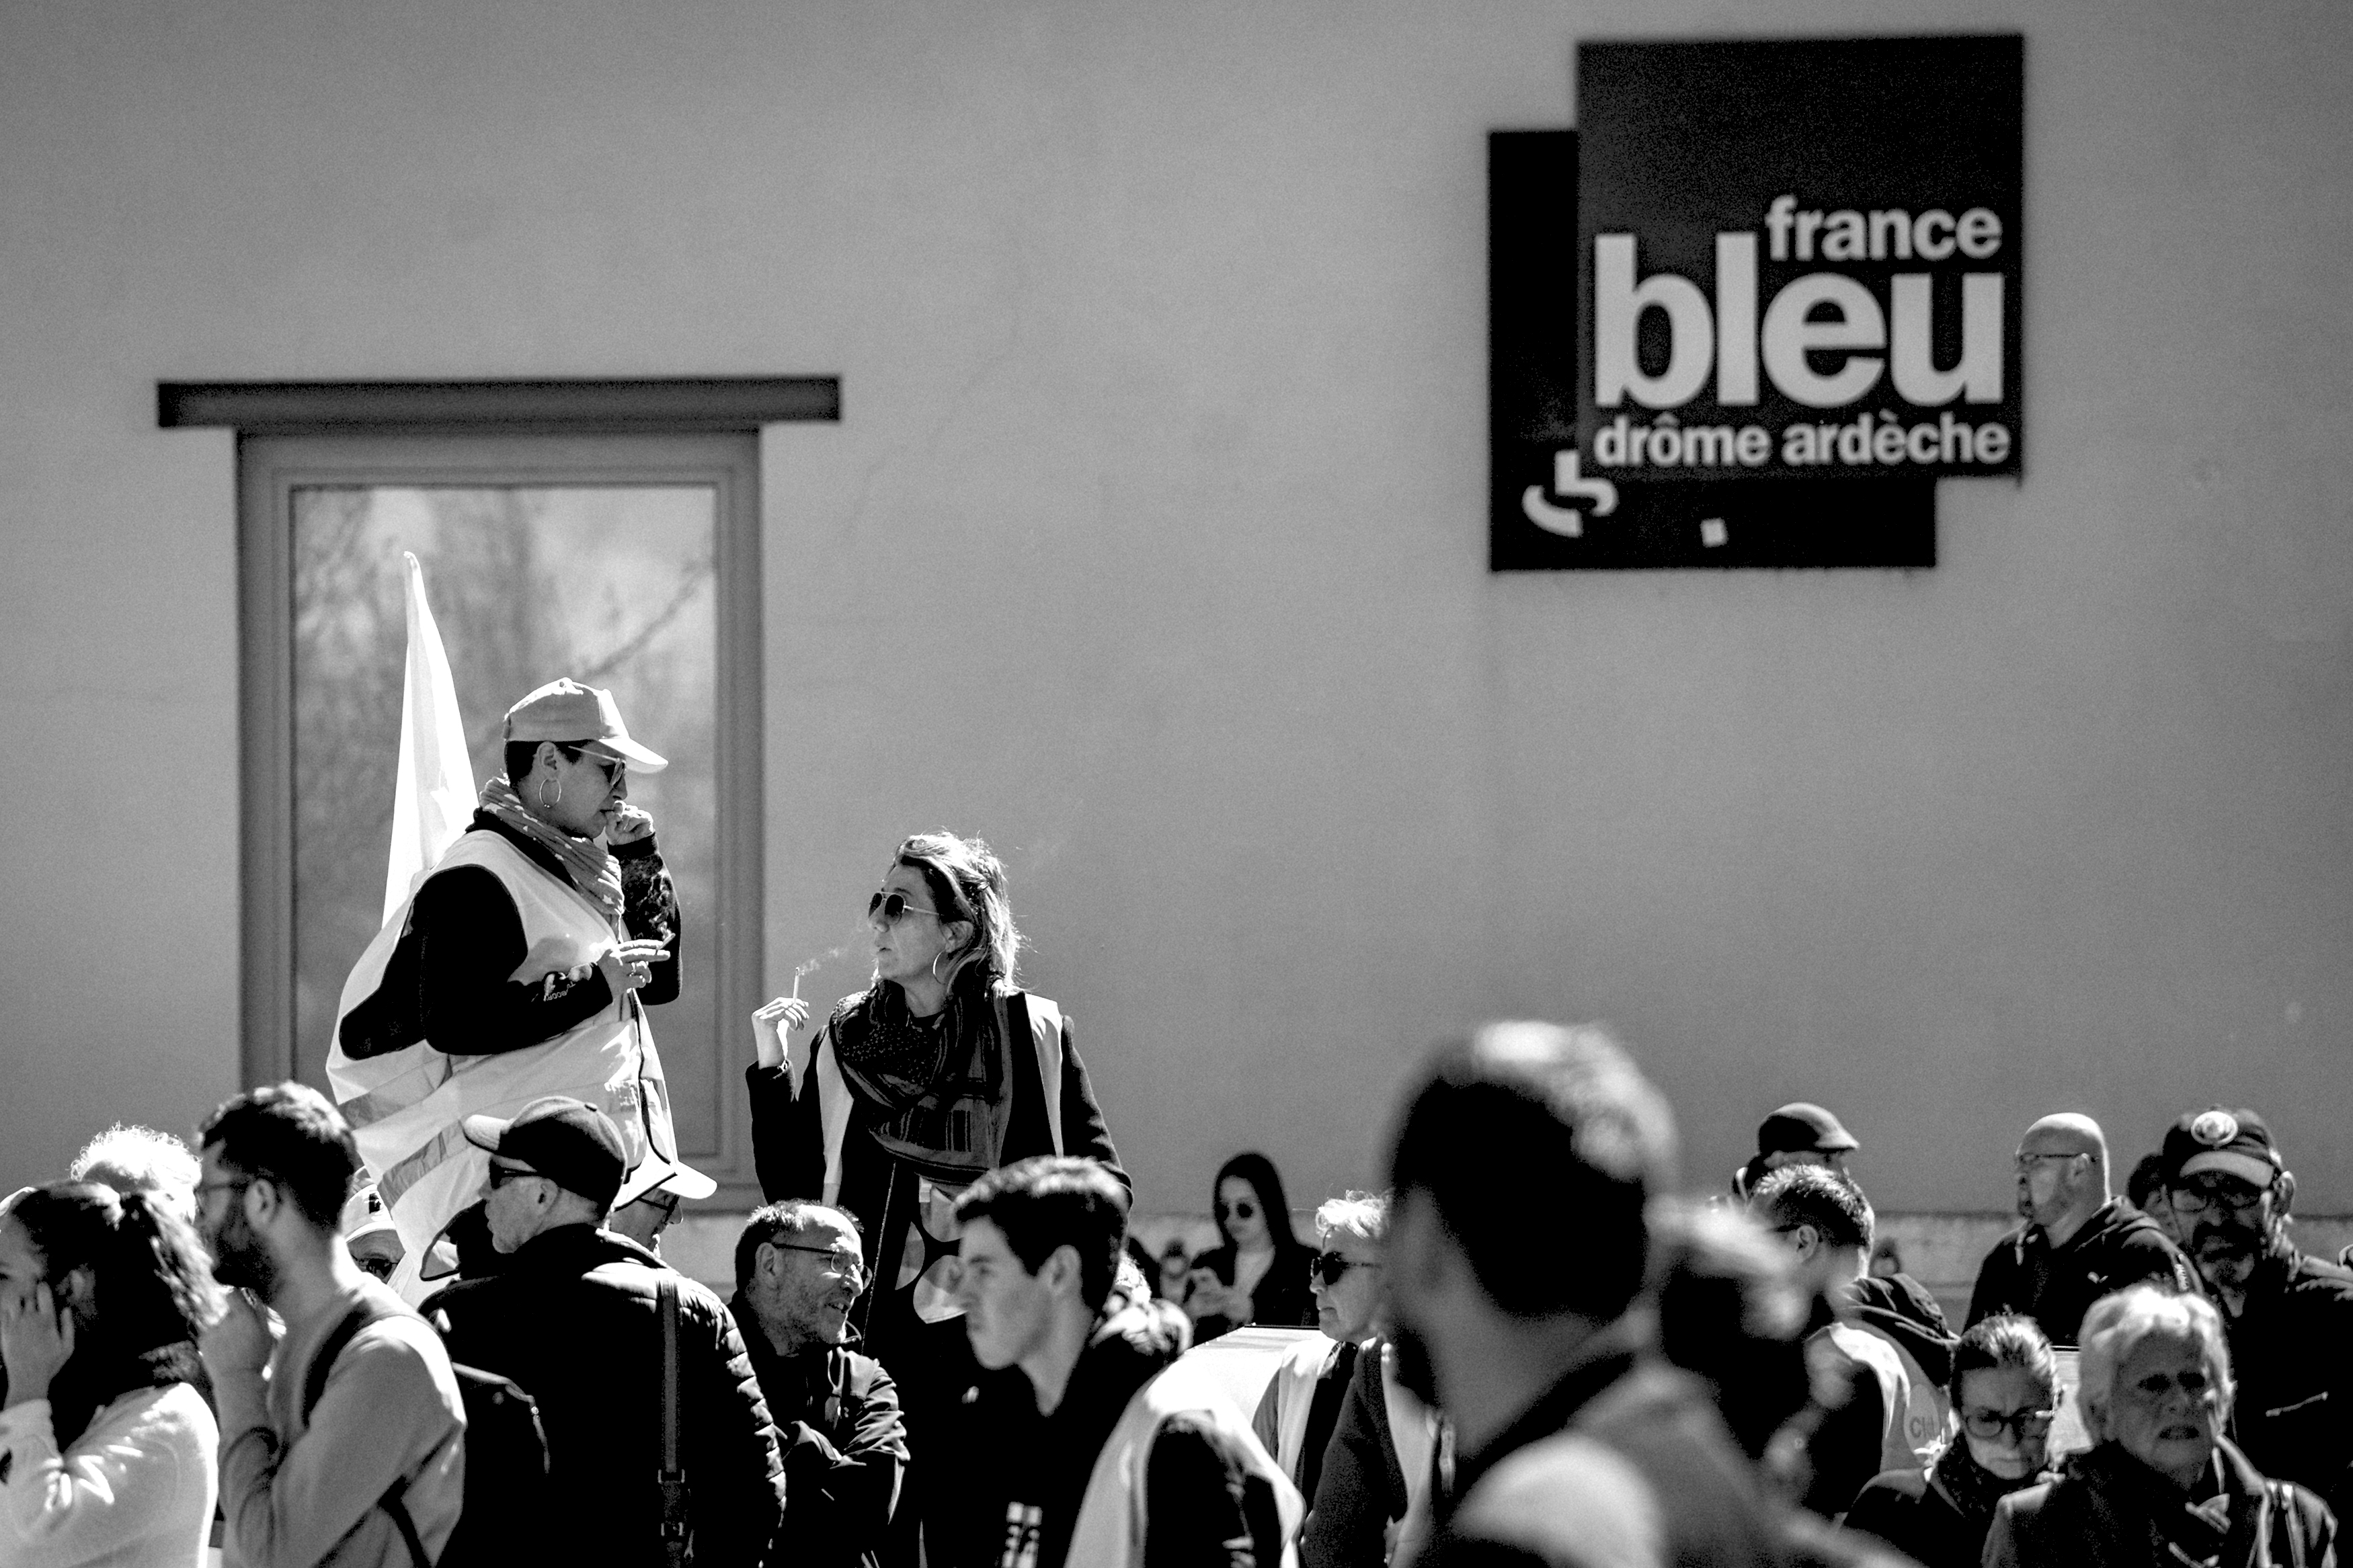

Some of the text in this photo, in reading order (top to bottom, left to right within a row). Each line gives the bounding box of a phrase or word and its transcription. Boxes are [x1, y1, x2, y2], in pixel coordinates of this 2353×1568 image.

[1765, 195, 2001, 260] france
[1595, 233, 2003, 409] bleu
[1593, 410, 2010, 466] drôme ardèche
